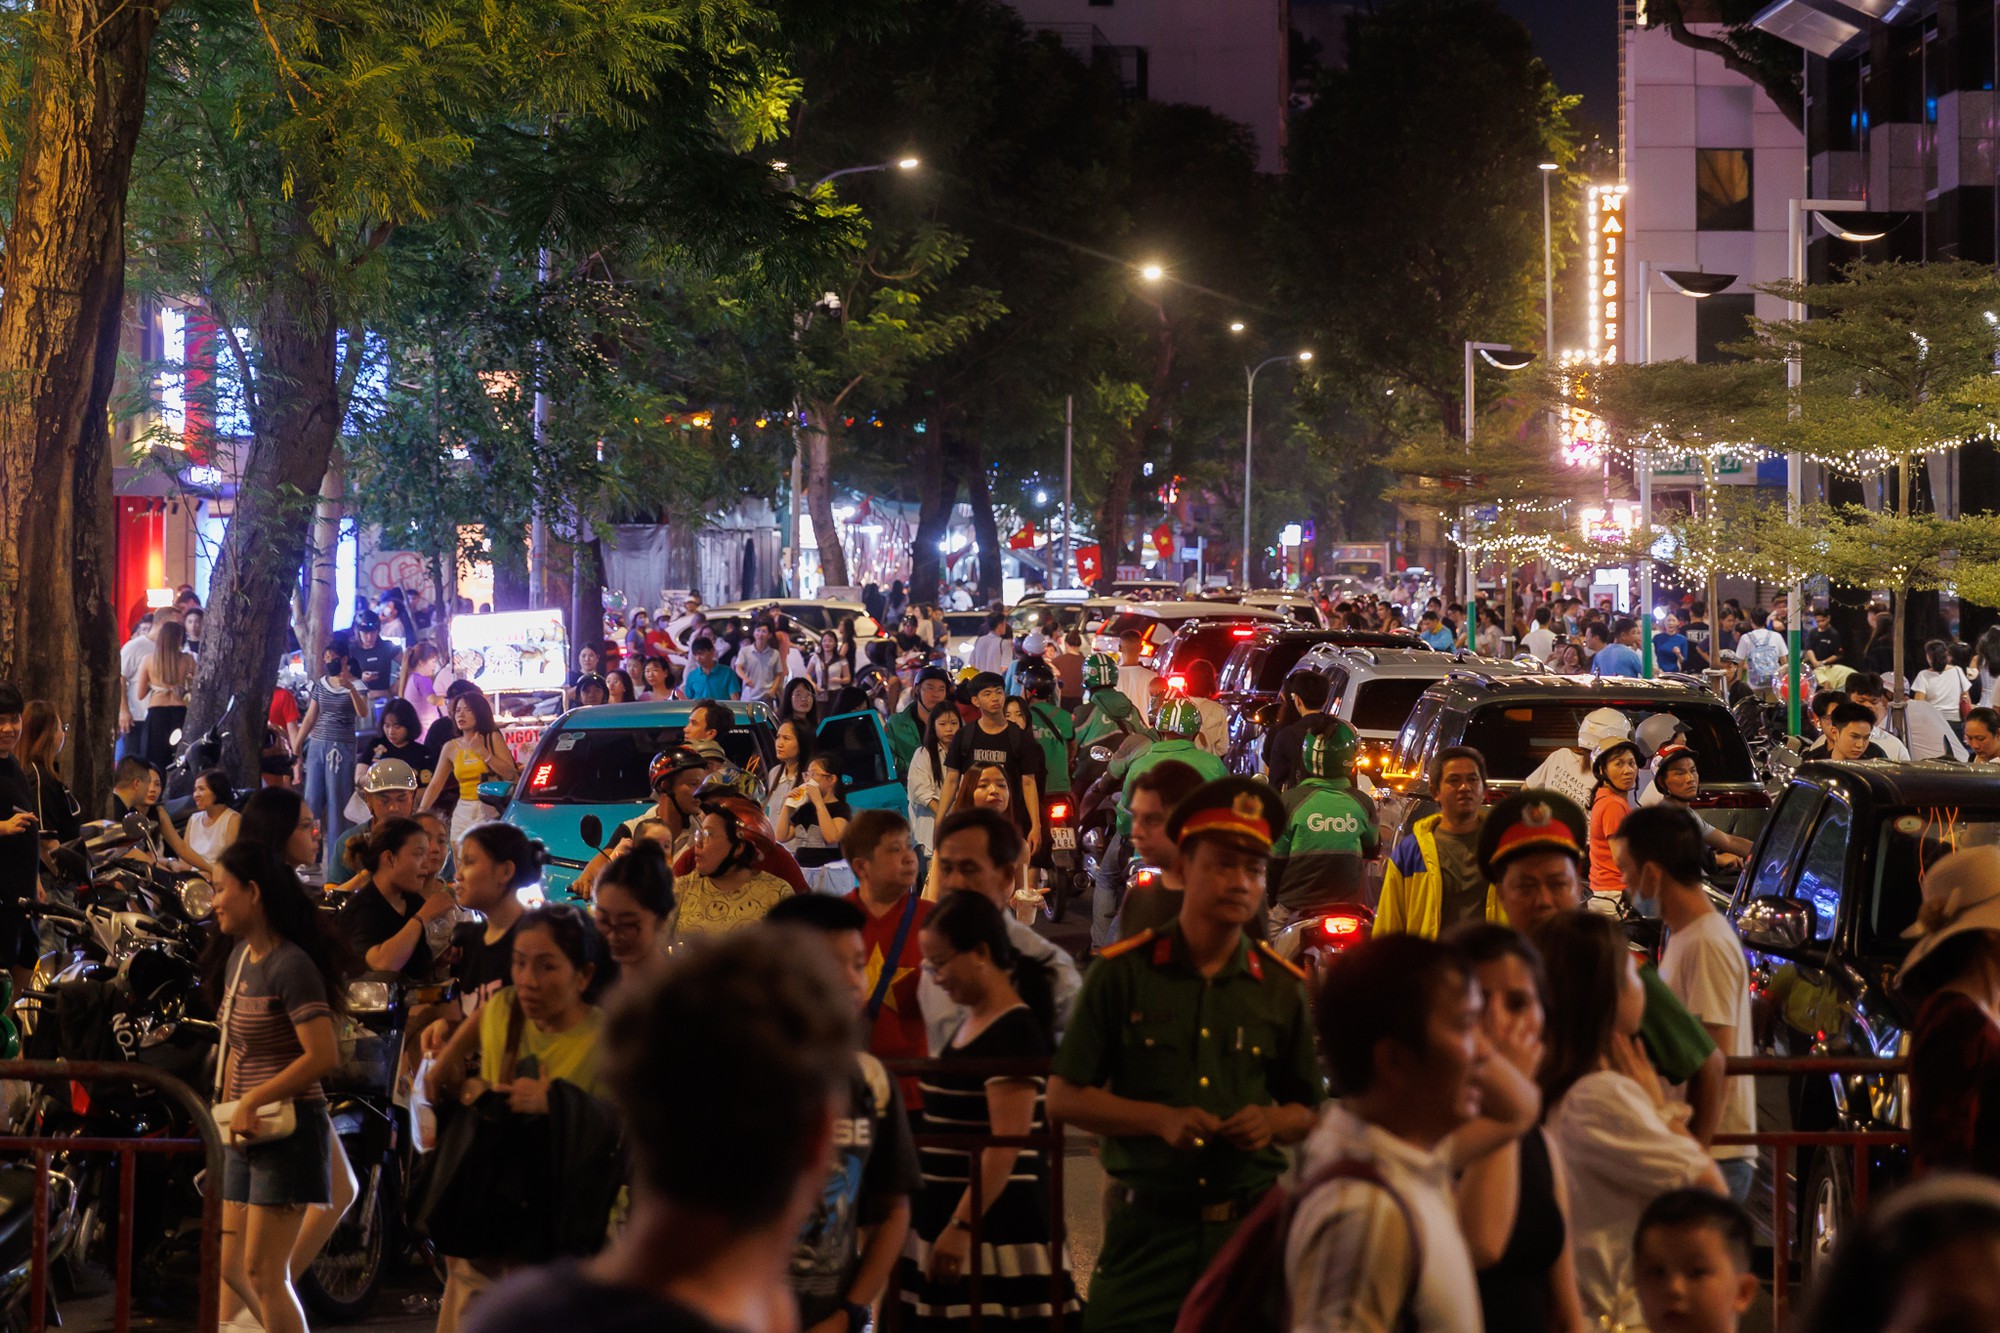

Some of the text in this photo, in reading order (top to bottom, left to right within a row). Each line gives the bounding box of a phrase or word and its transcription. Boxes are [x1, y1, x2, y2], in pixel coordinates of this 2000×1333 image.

[533, 764, 552, 785] TAXI
[1307, 813, 1358, 832] Grab
[833, 1117, 871, 1146] SE
